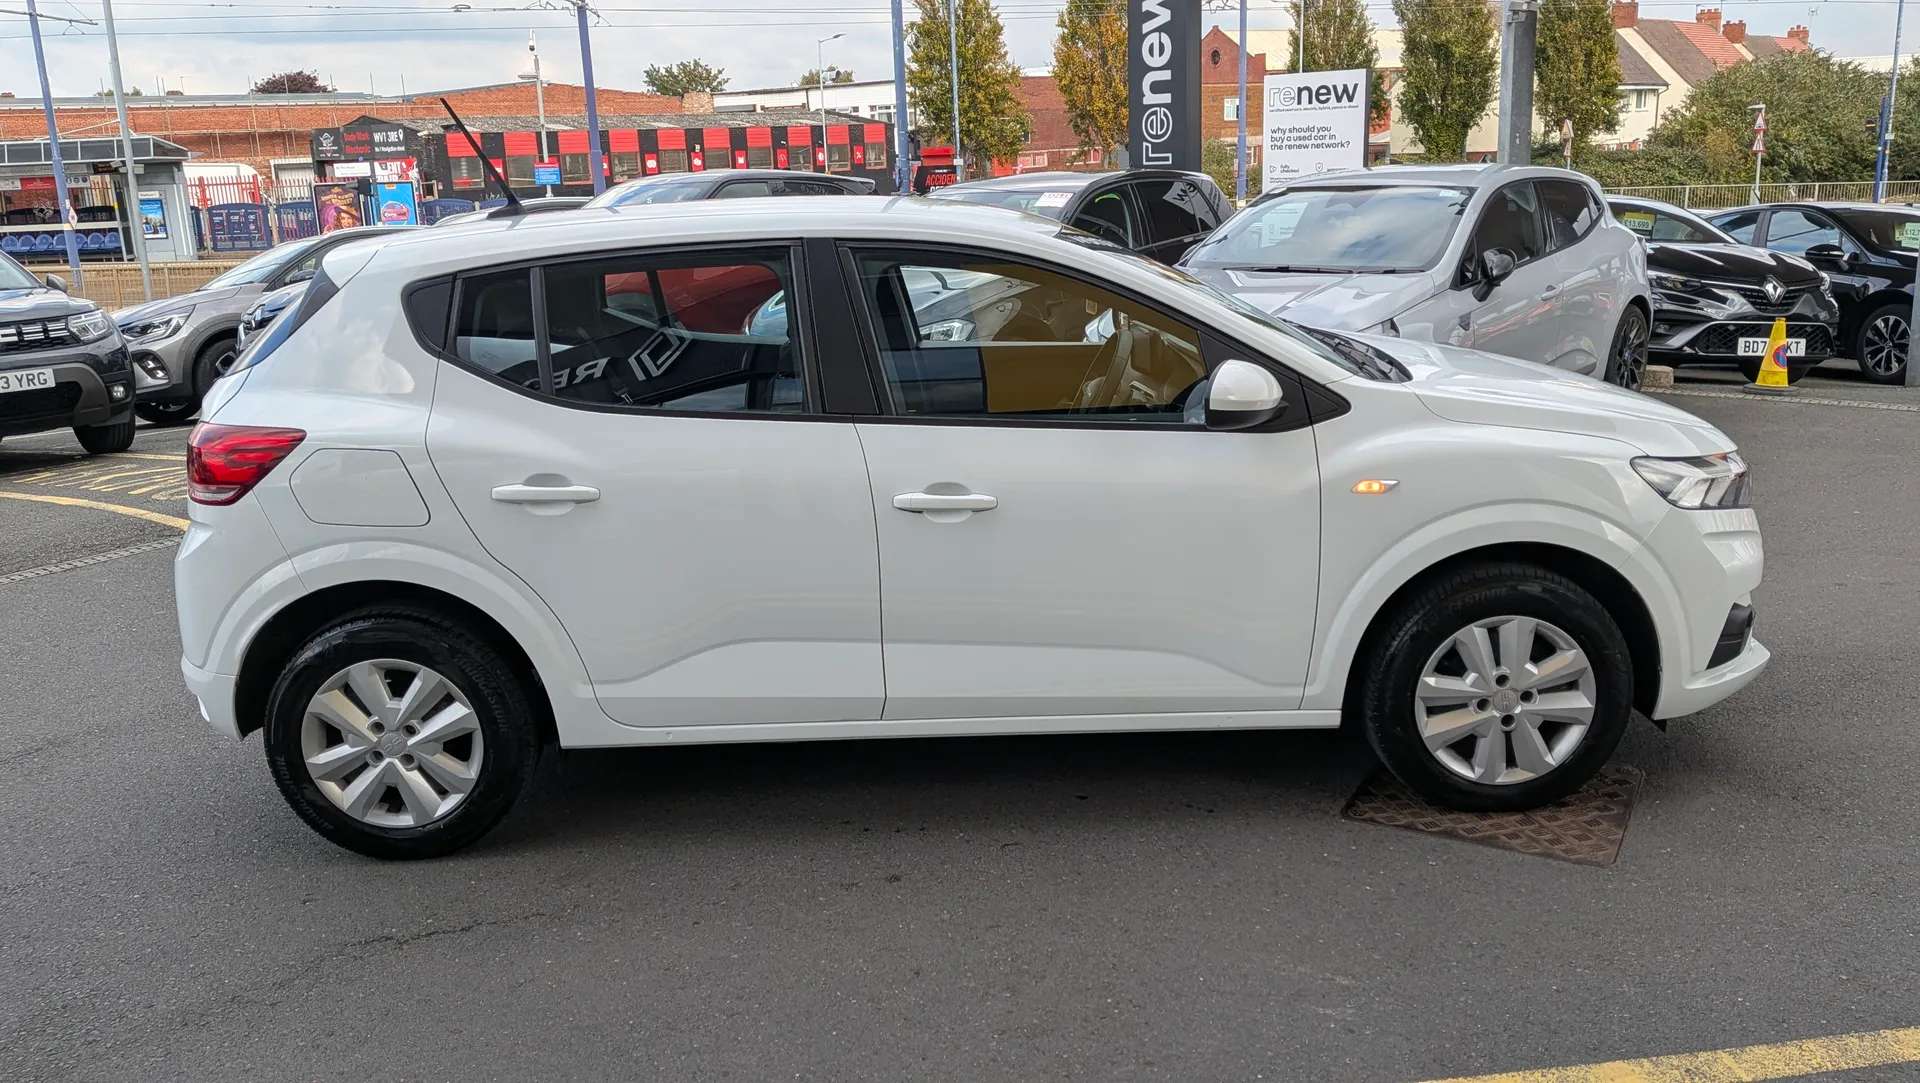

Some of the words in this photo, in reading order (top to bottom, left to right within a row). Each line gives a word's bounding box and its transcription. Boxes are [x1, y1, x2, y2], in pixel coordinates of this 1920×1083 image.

[1269, 83, 1359, 107] renew
[1270, 126, 1287, 135] why
[1288, 125, 1315, 134] should
[1316, 126, 1332, 134] you
[373, 131, 387, 143] WV1
[1270, 134, 1285, 143] buy
[1293, 133, 1312, 142] used
[1328, 132, 1336, 140] in
[1310, 140, 1350, 149] network?
[925, 173, 956, 186] ACCIDEN
[1743, 340, 1768, 353] BD7
[1787, 340, 1801, 354] KT
[14, 371, 48, 388] YRG
